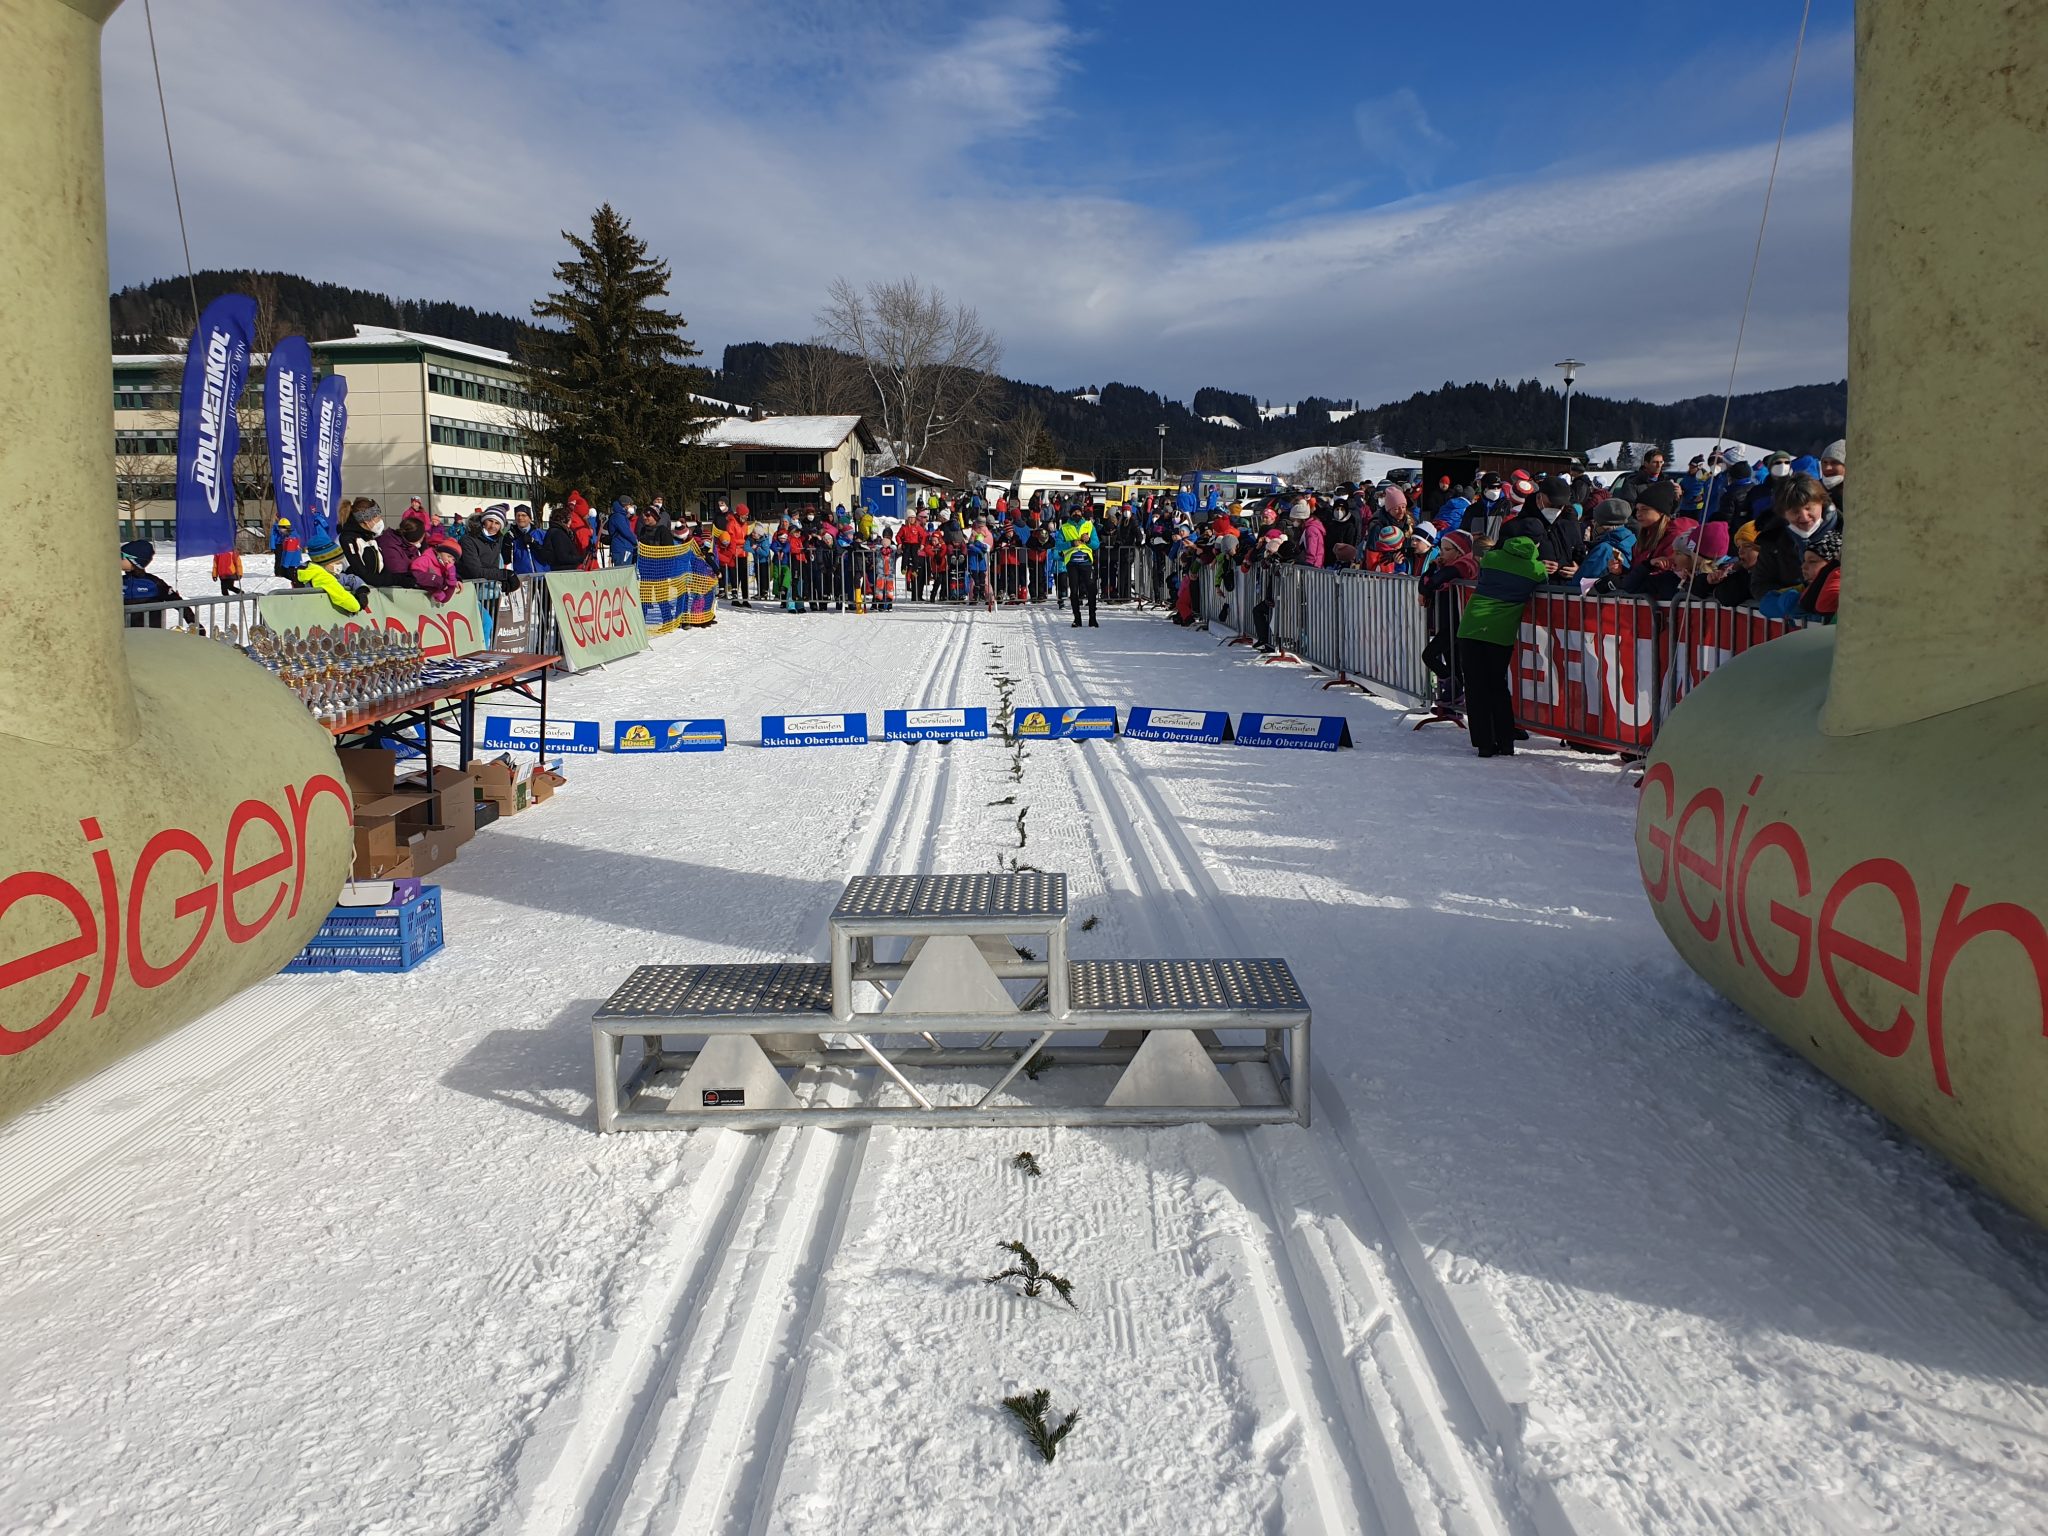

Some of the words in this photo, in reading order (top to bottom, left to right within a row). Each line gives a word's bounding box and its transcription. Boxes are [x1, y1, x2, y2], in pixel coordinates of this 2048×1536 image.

[234, 340, 247, 362] WIN
[300, 393, 307, 403] TO
[196, 328, 231, 489] HOLMENKOL
[300, 406, 308, 439] LICENSE
[279, 368, 300, 496] HOLMENKOL
[316, 399, 334, 501] HOLMENKOL
[787, 721, 842, 732] Oberstaufen
[909, 715, 962, 726] Oberstaufen
[1151, 715, 1201, 727] Oberstaufen
[1263, 721, 1316, 733] Oberstaufen
[513, 726, 571, 737] Oberaufen
[886, 730, 923, 740] Skiclub
[926, 728, 985, 739] Oberstaufen
[1125, 728, 1160, 739] Skiclub
[1162, 731, 1219, 744] Oberstaufen
[486, 739, 526, 750] Skiclub
[529, 741, 595, 753] Oerstaufen
[763, 736, 801, 746] Skiclub
[804, 734, 865, 745] Oberstaufen
[1236, 735, 1272, 747] Skiclub
[1275, 737, 1335, 750] Oberstaufen
[0, 774, 355, 1056] eiGer
